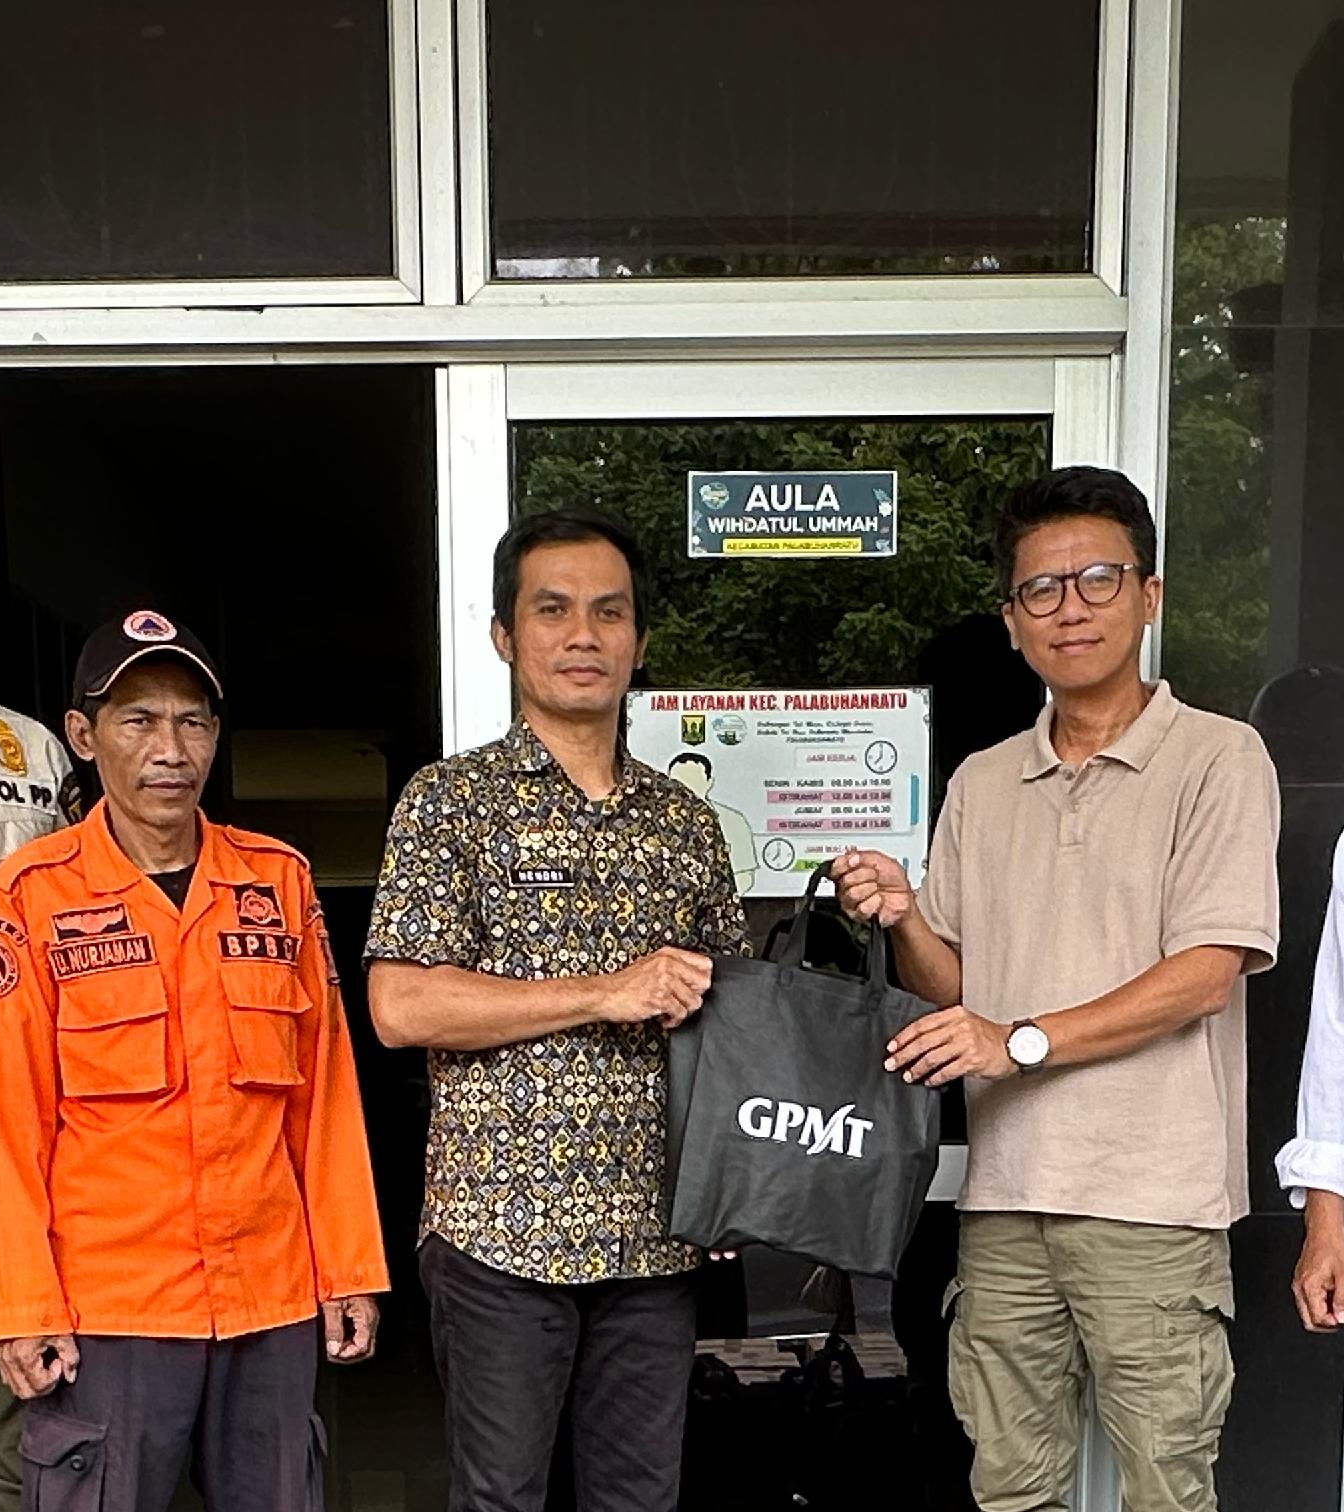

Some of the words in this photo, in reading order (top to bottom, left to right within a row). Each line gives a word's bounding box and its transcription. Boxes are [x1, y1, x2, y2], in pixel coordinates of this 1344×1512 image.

[745, 484, 840, 511] AULA
[708, 517, 804, 533] WIHDATUL
[808, 517, 878, 533] UMMAH
[650, 694, 679, 711] JAM
[682, 694, 745, 711] LAYANAN
[748, 694, 781, 711] KEC.
[784, 692, 908, 711] PALABUHANRATU
[29, 784, 52, 808] PP
[738, 1097, 874, 1158] GPMT
